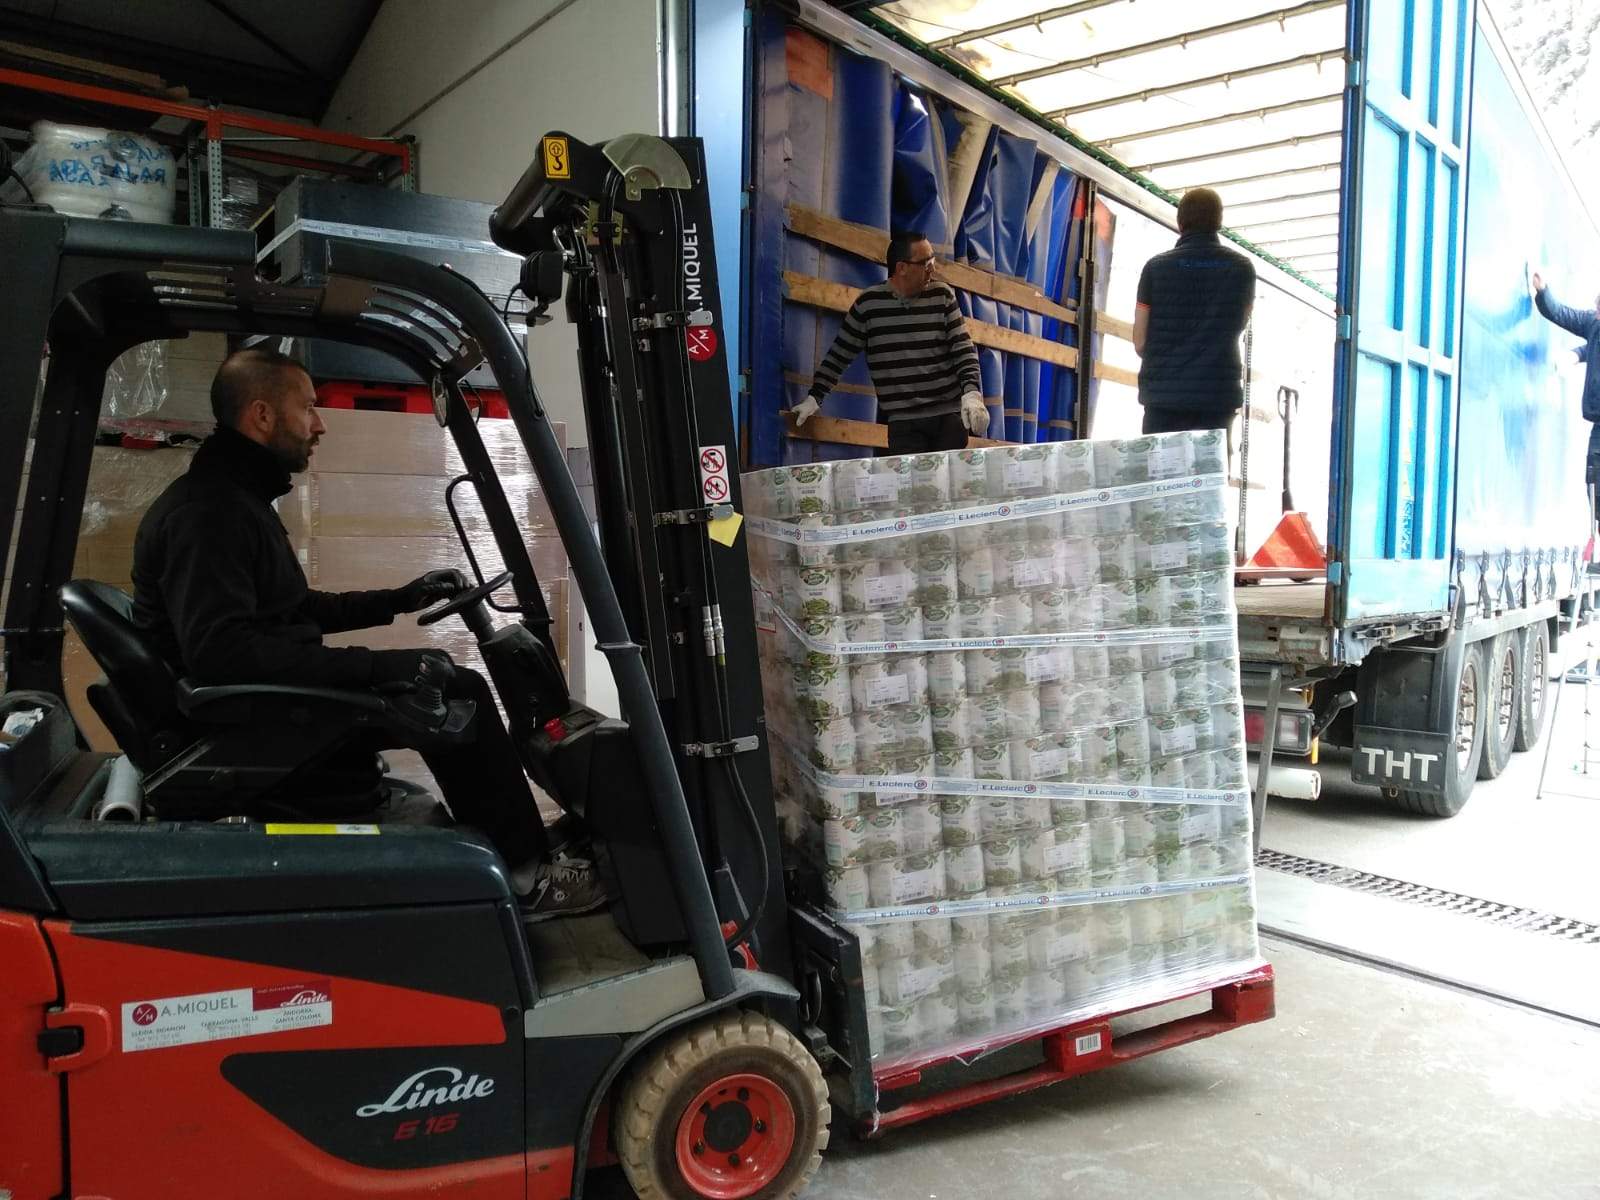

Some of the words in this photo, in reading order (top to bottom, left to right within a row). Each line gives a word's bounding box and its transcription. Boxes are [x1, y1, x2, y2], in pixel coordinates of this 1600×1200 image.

[683, 222, 704, 312] .MIQUEL
[1360, 746, 1439, 782] THT
[160, 997, 239, 1018] A.MIQUEL
[279, 989, 328, 1008] Linde
[355, 1066, 495, 1117] Linde
[393, 1119, 421, 1142] E
[424, 1113, 461, 1136] 16
